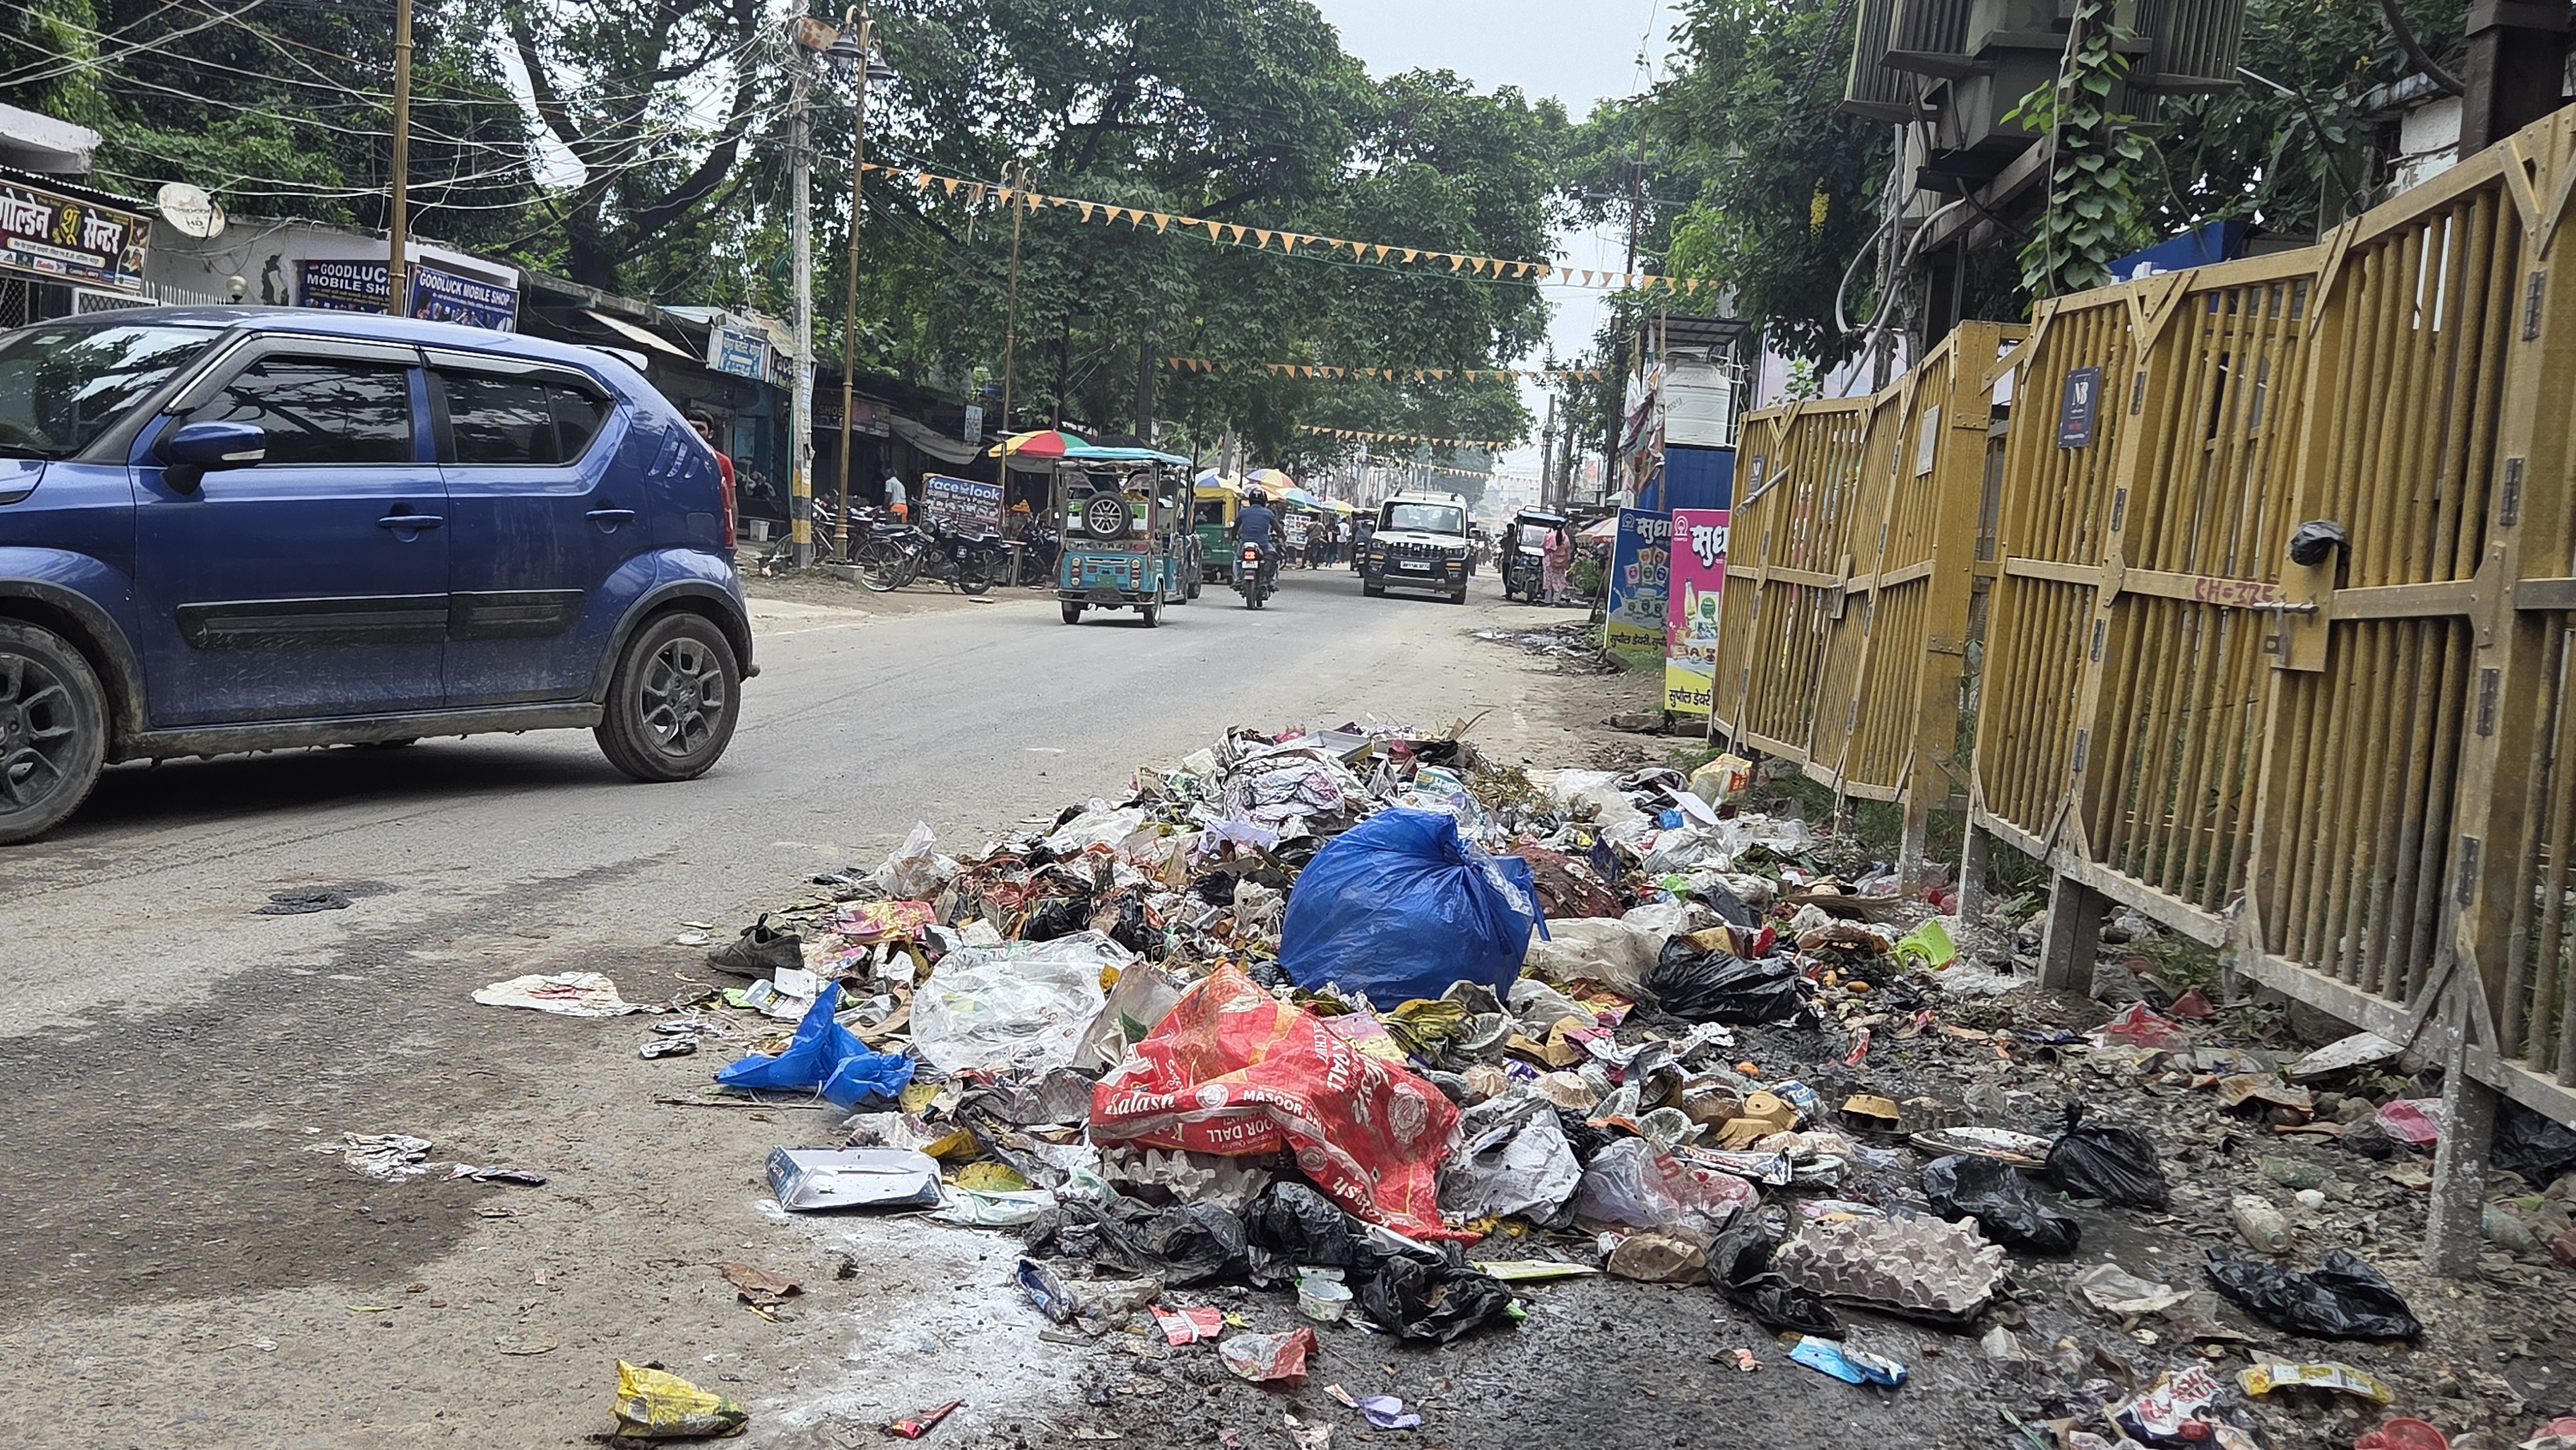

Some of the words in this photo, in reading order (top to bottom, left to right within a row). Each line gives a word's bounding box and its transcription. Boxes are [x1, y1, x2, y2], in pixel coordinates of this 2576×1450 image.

[307, 274, 361, 292] MOBILE
[320, 263, 392, 285] GOODLUC
[419, 272, 462, 296] GOODLUCK
[462, 281, 489, 303] MOBILE
[491, 290, 510, 306] SHOP
[928, 477, 959, 493] face
[970, 484, 1000, 501] look
[1652, 636, 1667, 651] सुपौ
[1669, 685, 1692, 708] सुपौल
[1104, 1093, 1175, 1115] Kalash
[1243, 1089, 1303, 1116] MASOOR
[1207, 1125, 1243, 1142] DALL
